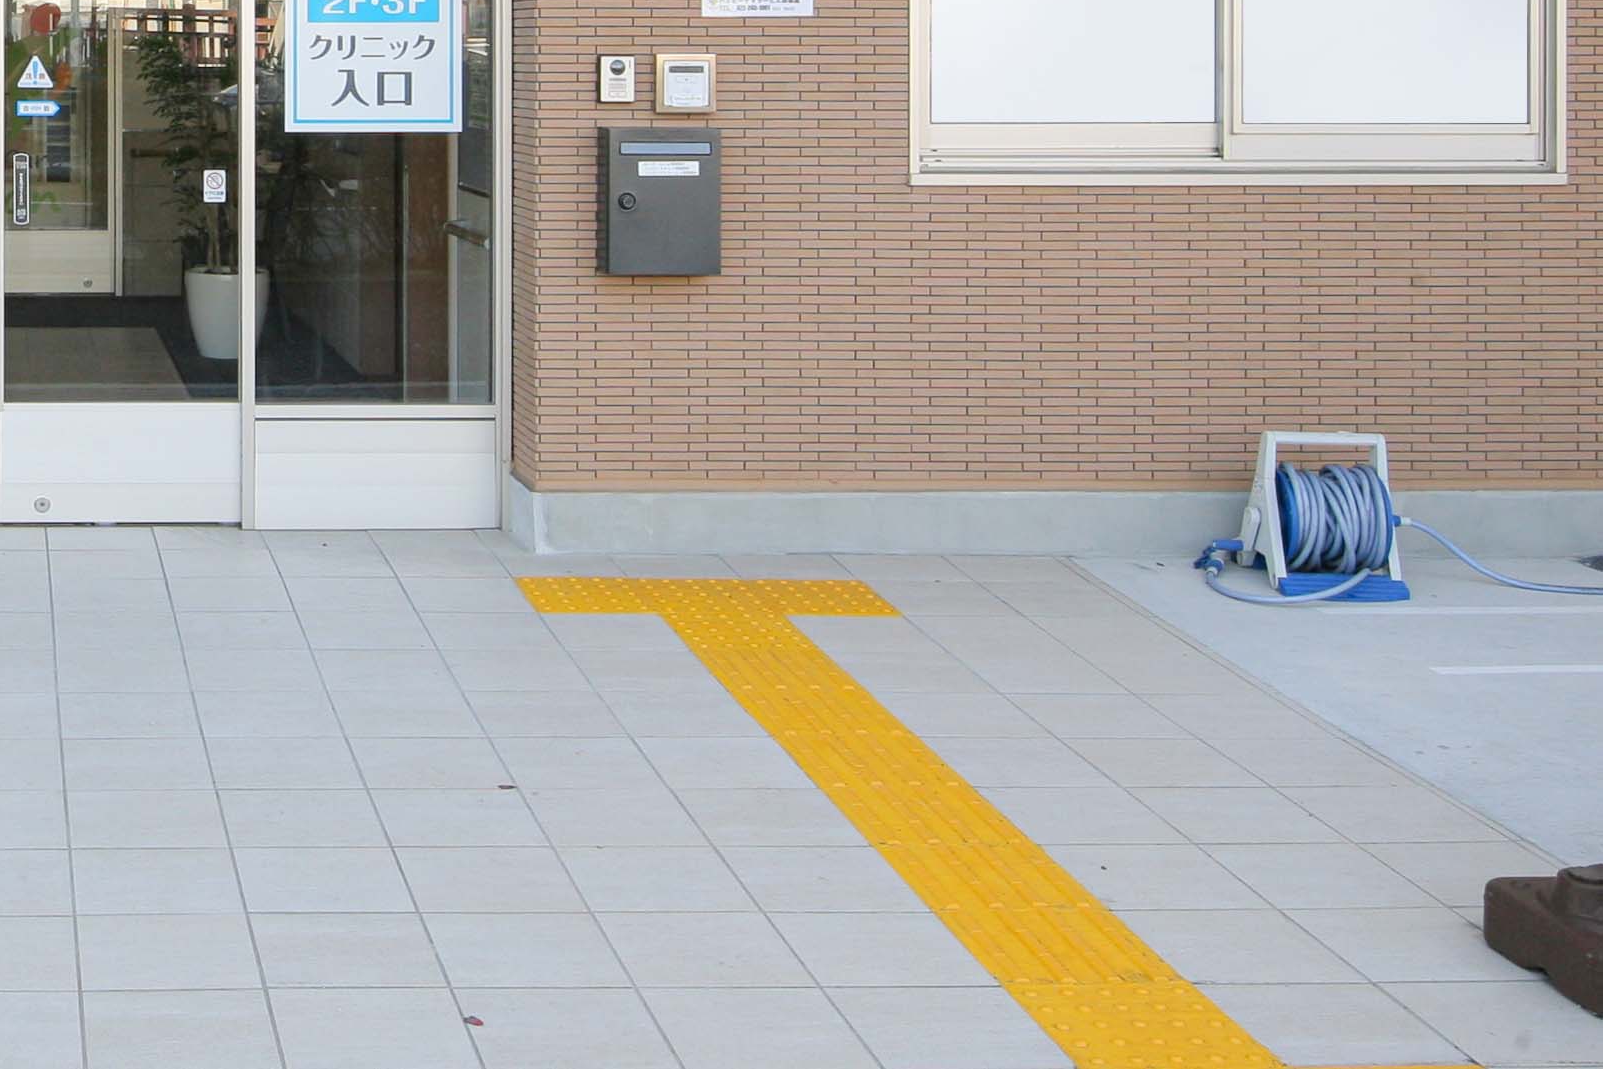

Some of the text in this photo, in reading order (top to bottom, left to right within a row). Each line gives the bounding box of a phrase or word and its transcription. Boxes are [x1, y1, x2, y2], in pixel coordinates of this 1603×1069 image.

[309, 34, 436, 60] クリニック
[331, 69, 413, 107] 入口
